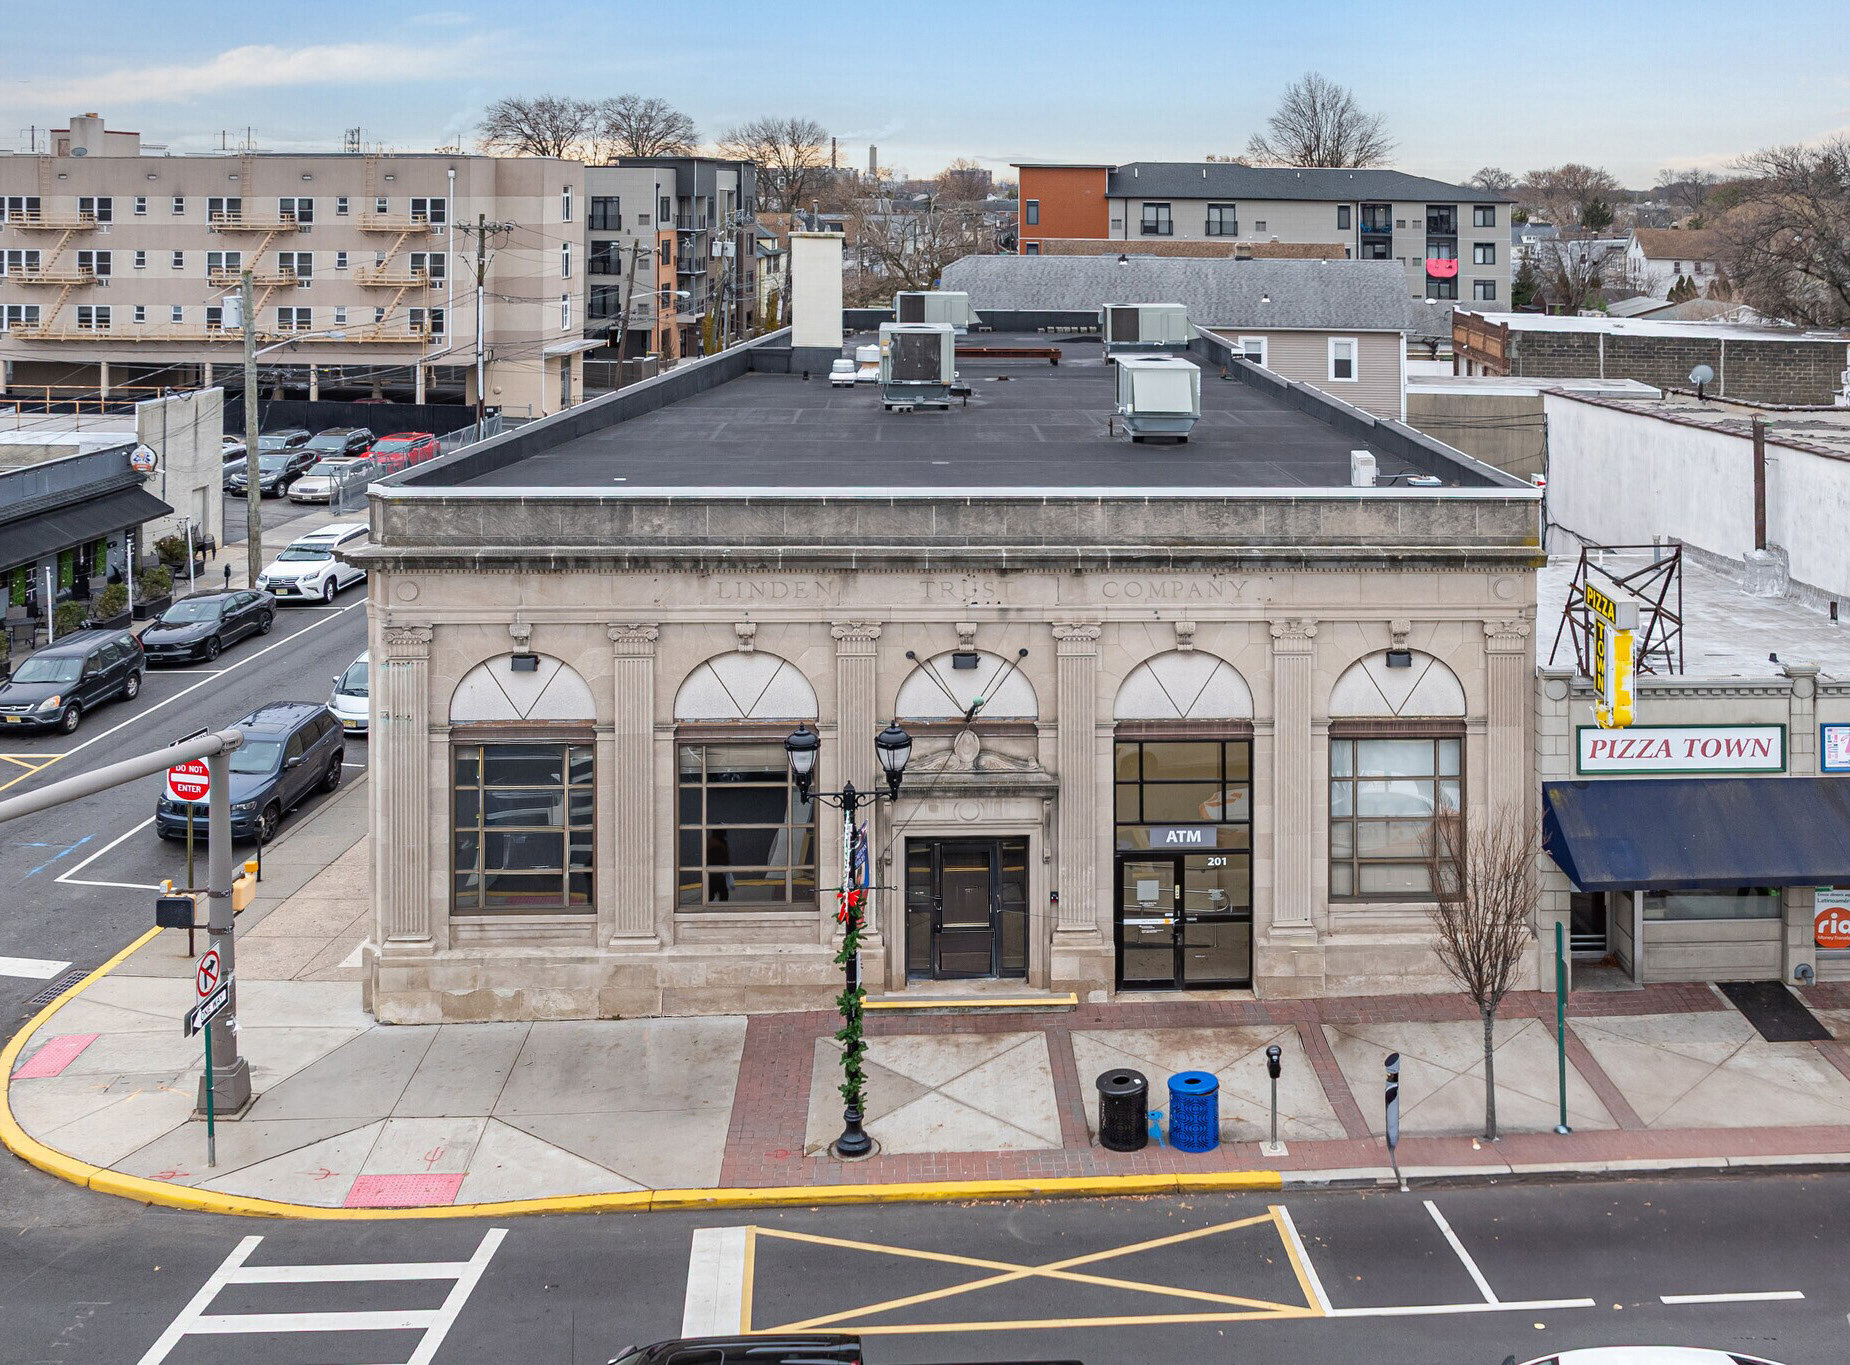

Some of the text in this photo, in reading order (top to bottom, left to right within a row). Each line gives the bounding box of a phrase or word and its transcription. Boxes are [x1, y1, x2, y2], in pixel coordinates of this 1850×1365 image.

[717, 580, 1248, 599] LINDEN TRUST COMPANY
[1587, 586, 1615, 622] PIZZA
[1596, 621, 1605, 692] TOWN
[1588, 737, 1773, 759] PIZZA TOWN
[176, 764, 203, 774] DO NOT
[178, 783, 201, 793] ENTER
[1166, 830, 1201, 843] ATM
[1207, 857, 1227, 866] 201
[1818, 912, 1850, 934] ria
